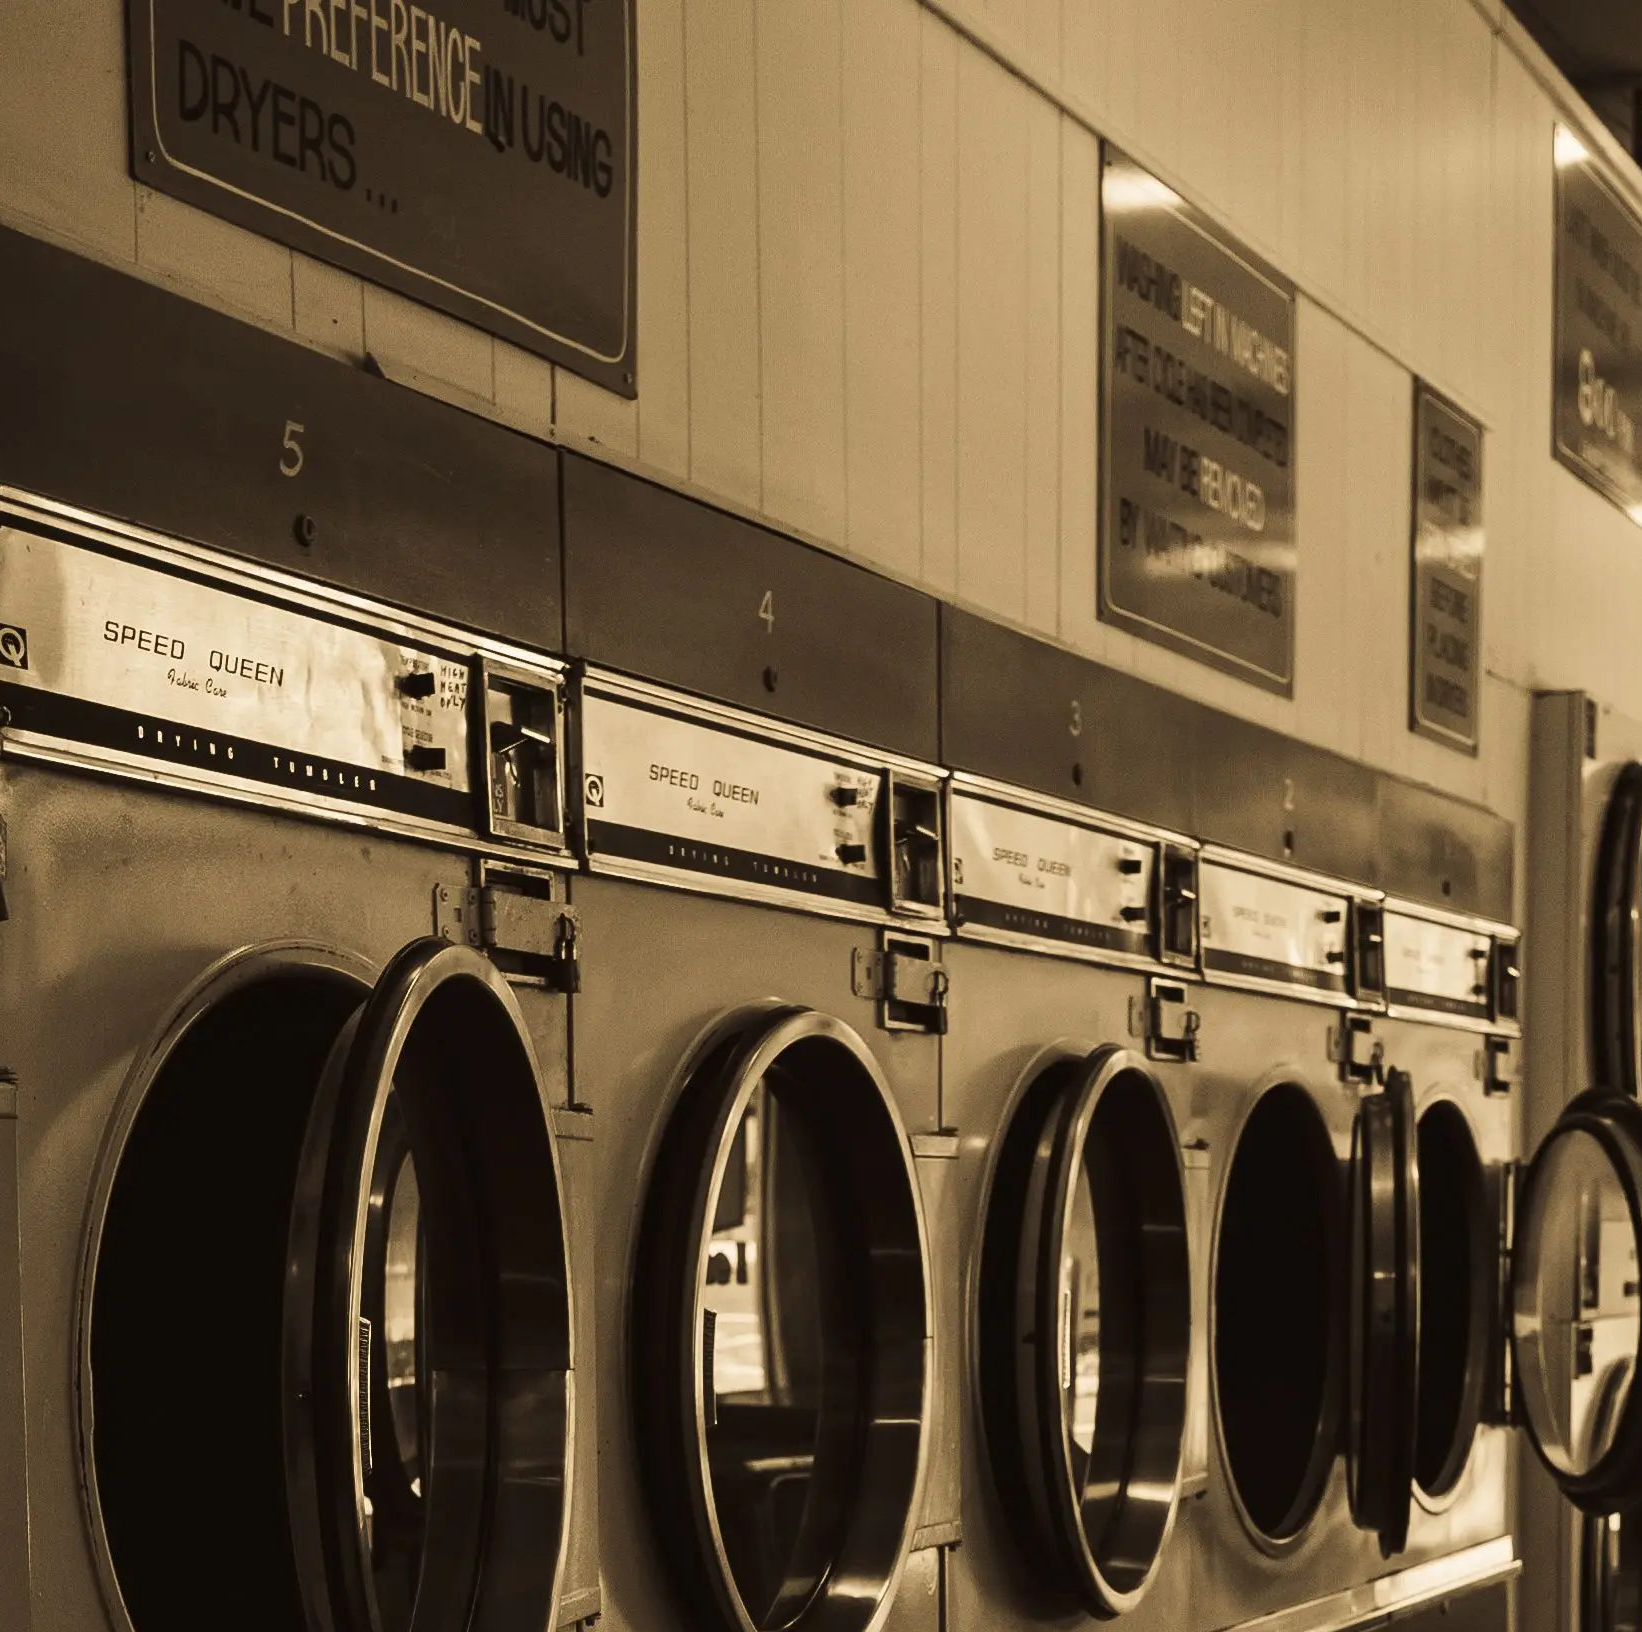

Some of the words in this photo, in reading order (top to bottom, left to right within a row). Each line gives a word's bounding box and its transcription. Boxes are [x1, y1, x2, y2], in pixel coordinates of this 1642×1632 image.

[484, 65, 514, 150] IN
[521, 84, 613, 199] USING
[279, 420, 305, 478] 5
[758, 589, 776, 635] 4
[104, 621, 185, 660] SPEED
[209, 650, 284, 687] QUEEN
[1069, 700, 1083, 738] 3
[649, 764, 699, 791] SPEED
[713, 780, 760, 805] QUEEN
[993, 847, 1028, 868] SPEED
